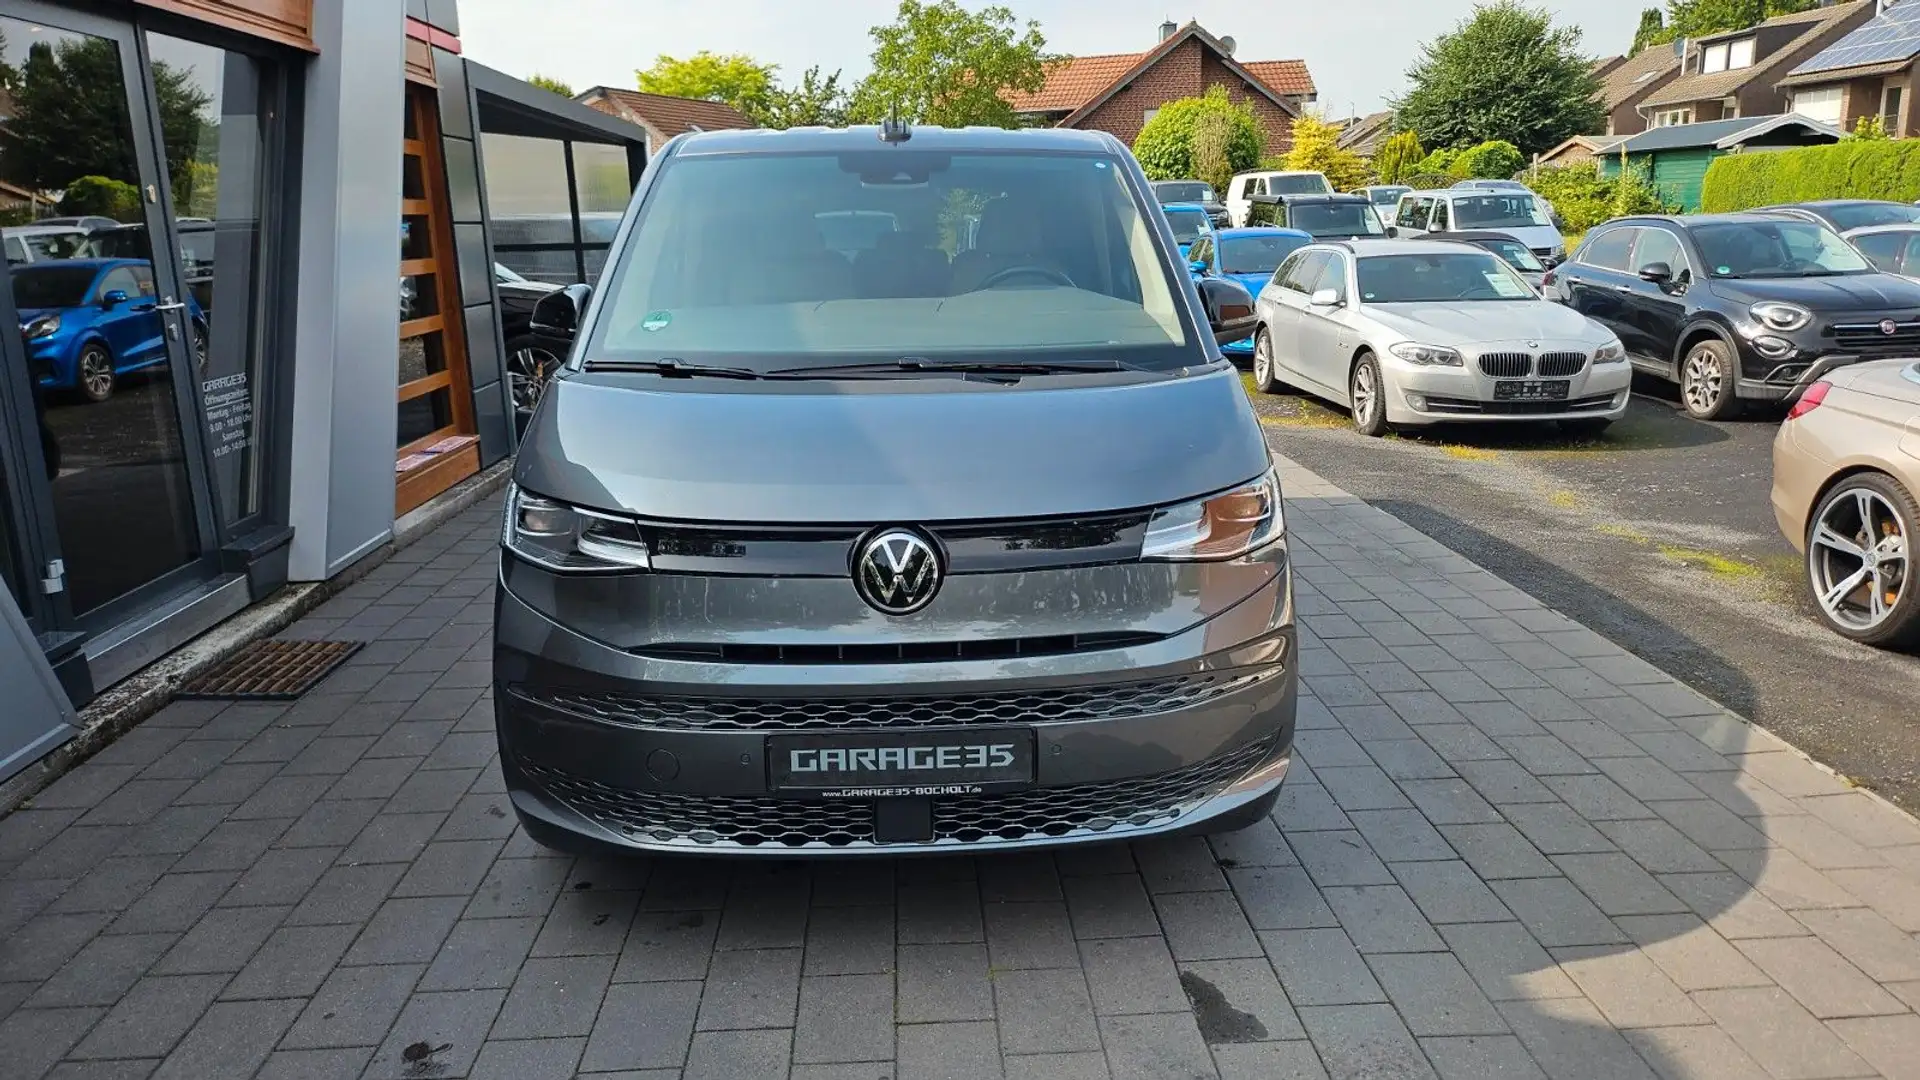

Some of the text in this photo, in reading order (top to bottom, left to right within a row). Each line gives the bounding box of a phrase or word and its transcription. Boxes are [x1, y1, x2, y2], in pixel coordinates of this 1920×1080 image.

[202, 373, 247, 392] GARAGE35
[790, 744, 1015, 772] GARAGE35
[822, 785, 982, 797] www.GARAGE35-BOCHOLT.de
